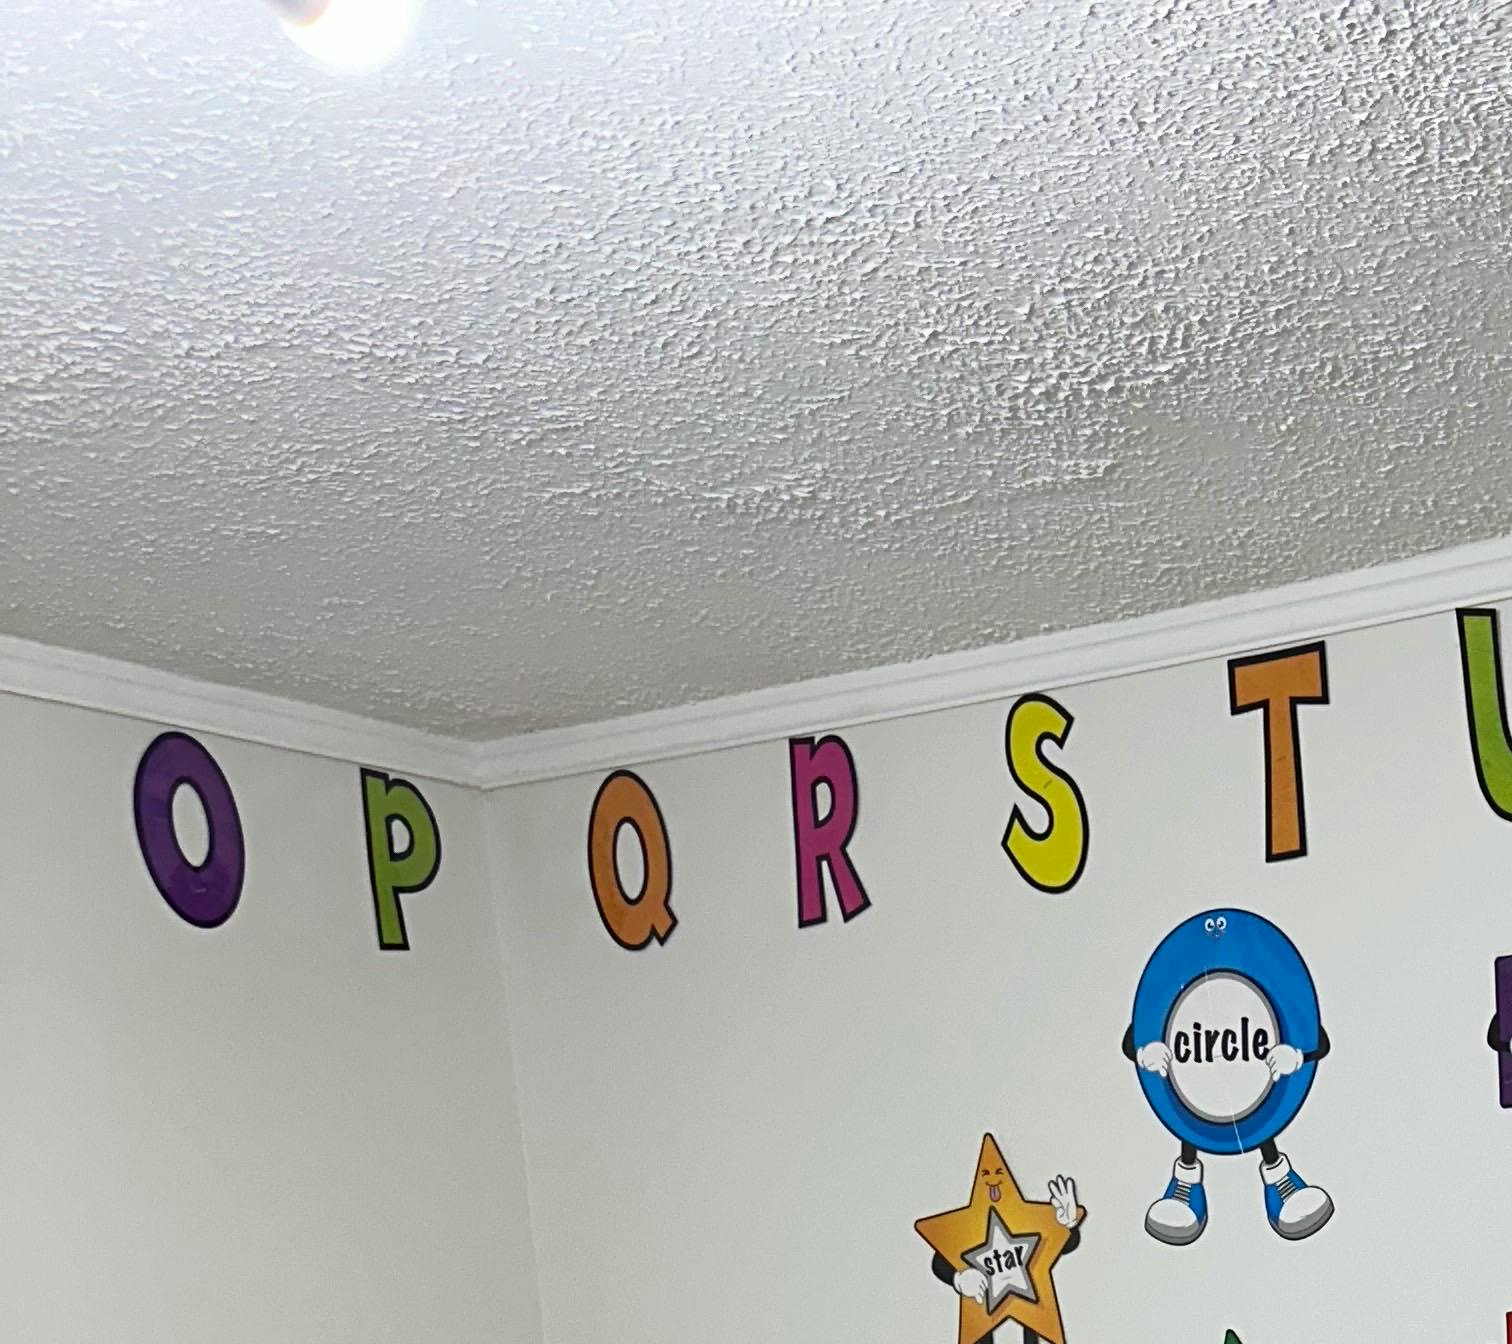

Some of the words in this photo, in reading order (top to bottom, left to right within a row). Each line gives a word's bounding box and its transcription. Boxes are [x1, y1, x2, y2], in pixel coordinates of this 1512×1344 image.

[133, 731, 245, 929] O
[360, 767, 442, 951] P
[587, 769, 678, 951] Q
[789, 734, 871, 929] R
[1001, 693, 1090, 894] S
[1228, 641, 1329, 863] T
[1174, 1017, 1270, 1063] circle
[983, 1246, 1024, 1275] star
